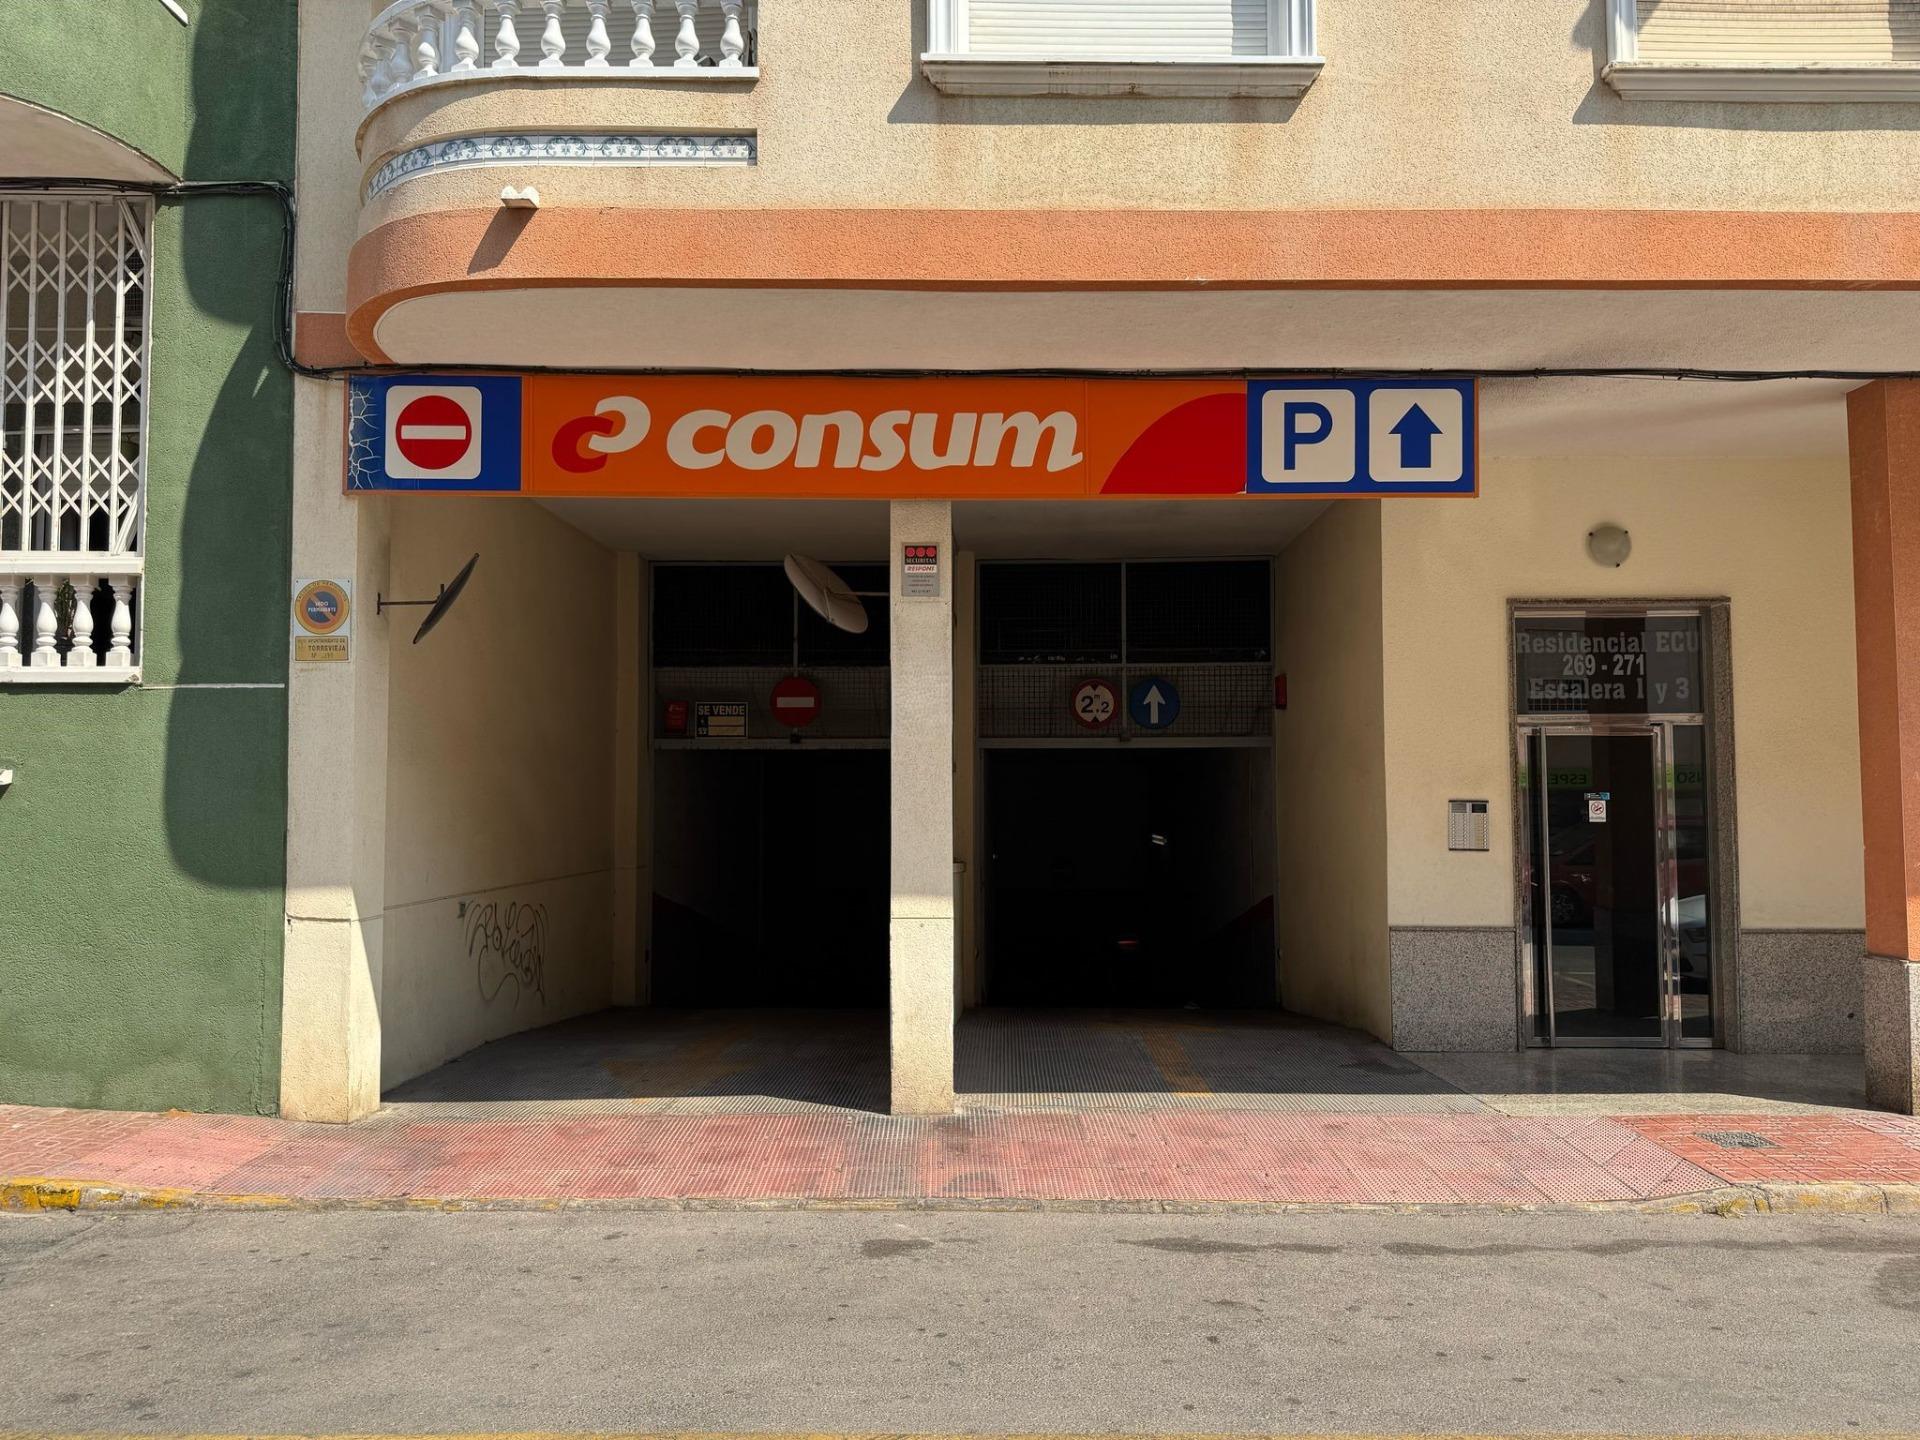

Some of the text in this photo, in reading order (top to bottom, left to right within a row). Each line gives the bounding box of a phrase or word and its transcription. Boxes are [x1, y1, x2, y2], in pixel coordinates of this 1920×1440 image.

[666, 408, 1084, 473] consum
[1283, 402, 1333, 471] P
[1516, 631, 1648, 654] Residencial
[1562, 653, 1596, 676] 269
[1613, 653, 1645, 676] 271
[1529, 676, 1626, 700] Escalera
[1655, 682, 1668, 704] y
[1675, 676, 1690, 699] 3
[698, 705, 711, 716] SE
[713, 705, 745, 716] VENDE
